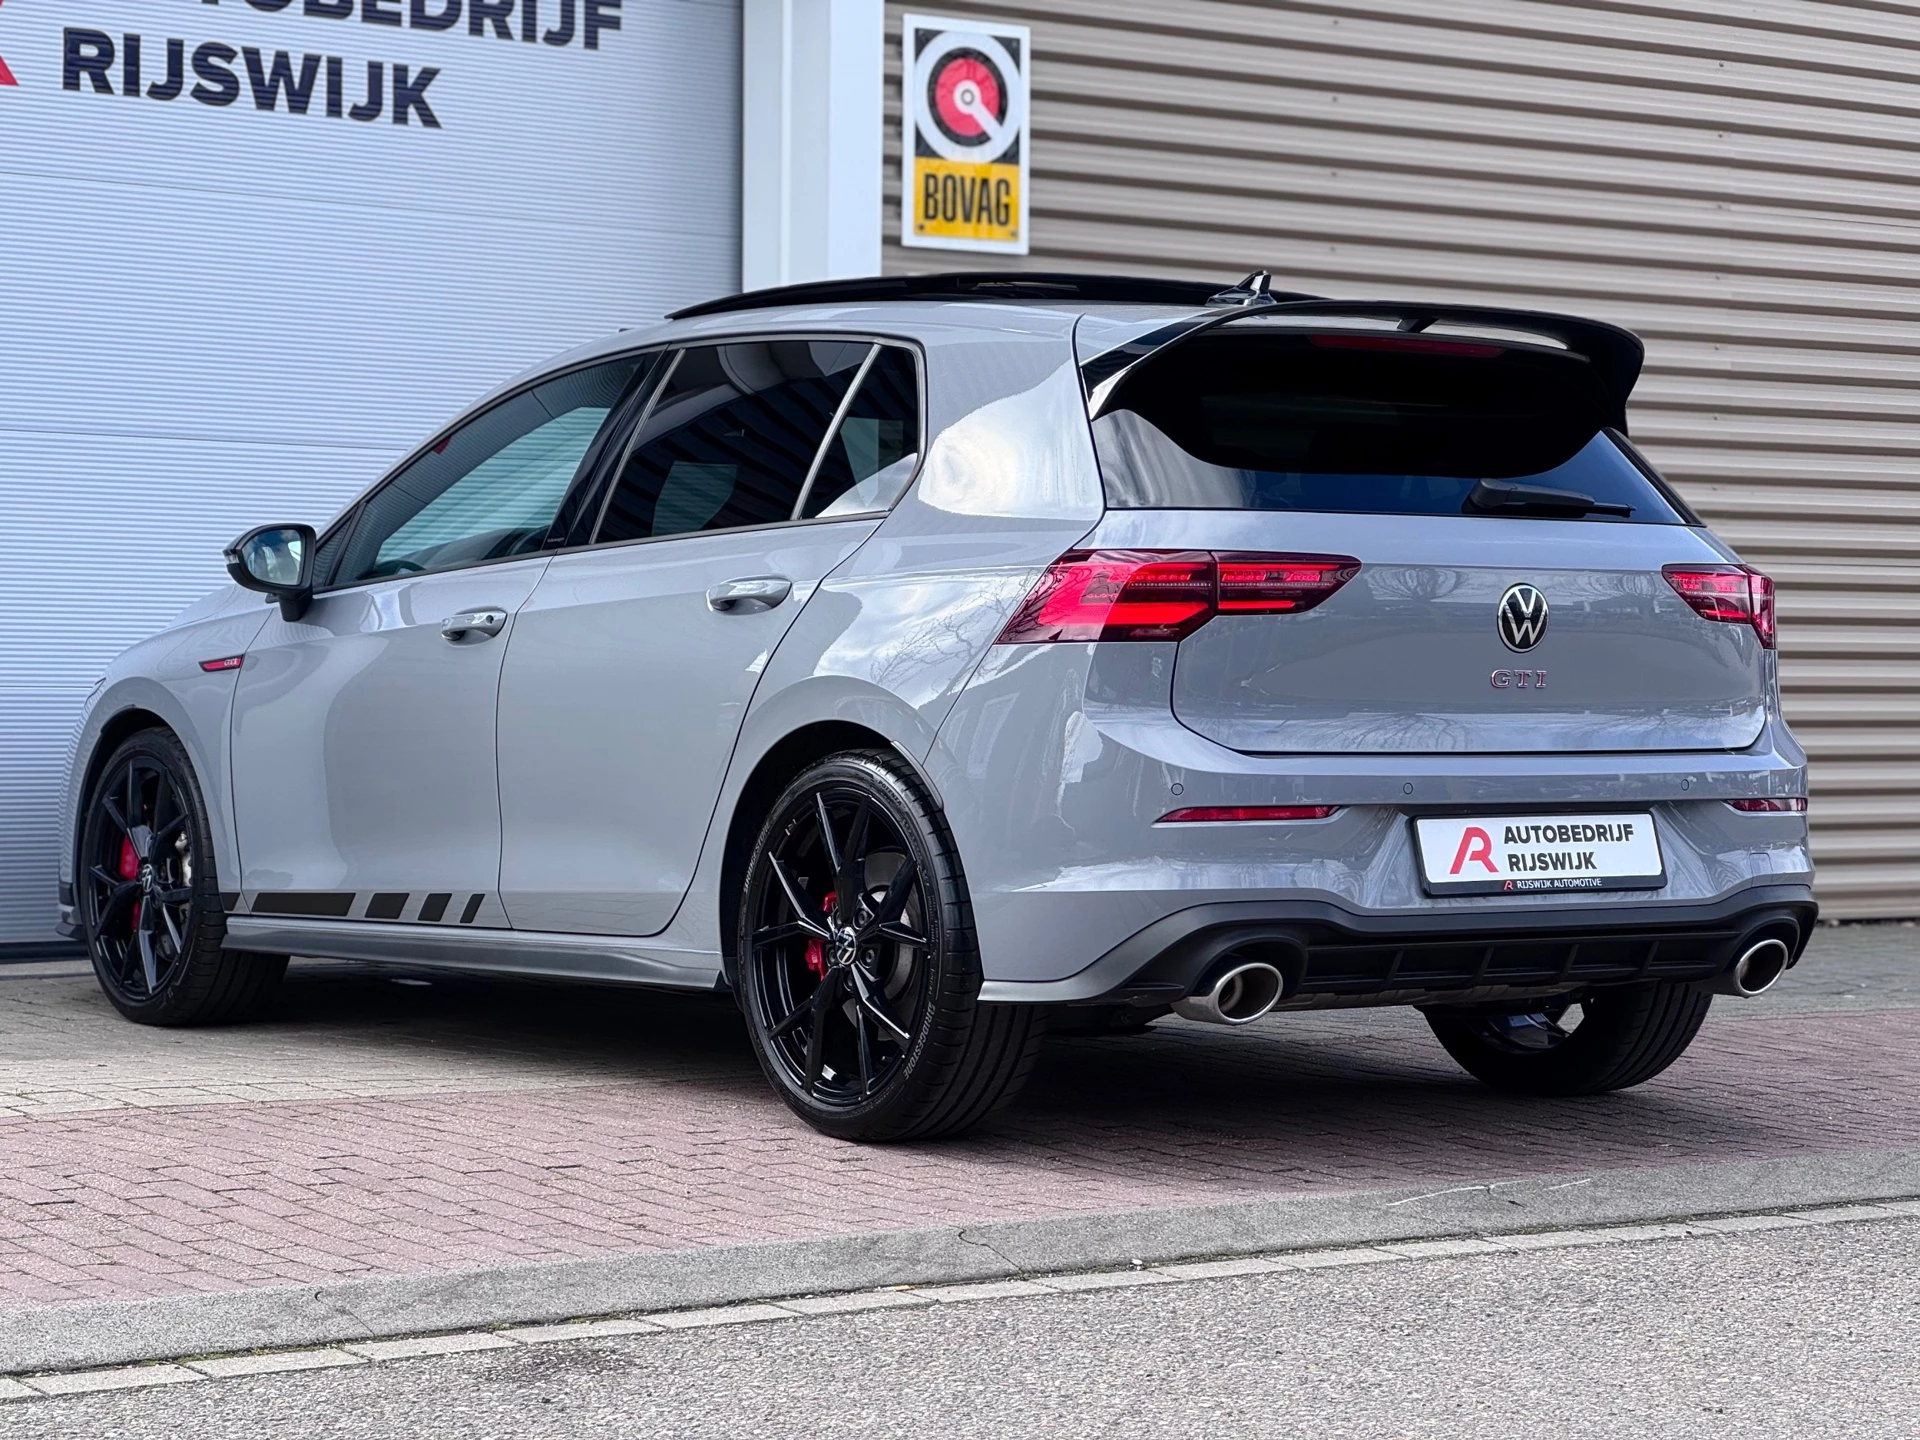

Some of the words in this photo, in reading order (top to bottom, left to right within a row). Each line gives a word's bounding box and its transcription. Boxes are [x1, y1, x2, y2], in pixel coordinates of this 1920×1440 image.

[62, 27, 442, 129] RIJSWIJK
[924, 173, 1010, 226] BOVAG
[1491, 669, 1547, 688] GTI
[1504, 824, 1634, 844] AUTOBEDRIJF
[1507, 852, 1597, 872] RIJSWIJK
[1517, 880, 1552, 889] RIJSWIJK
[1554, 878, 1602, 888] AUTOMOTIVE
[903, 1001, 936, 1080] BRIDGESTONE
